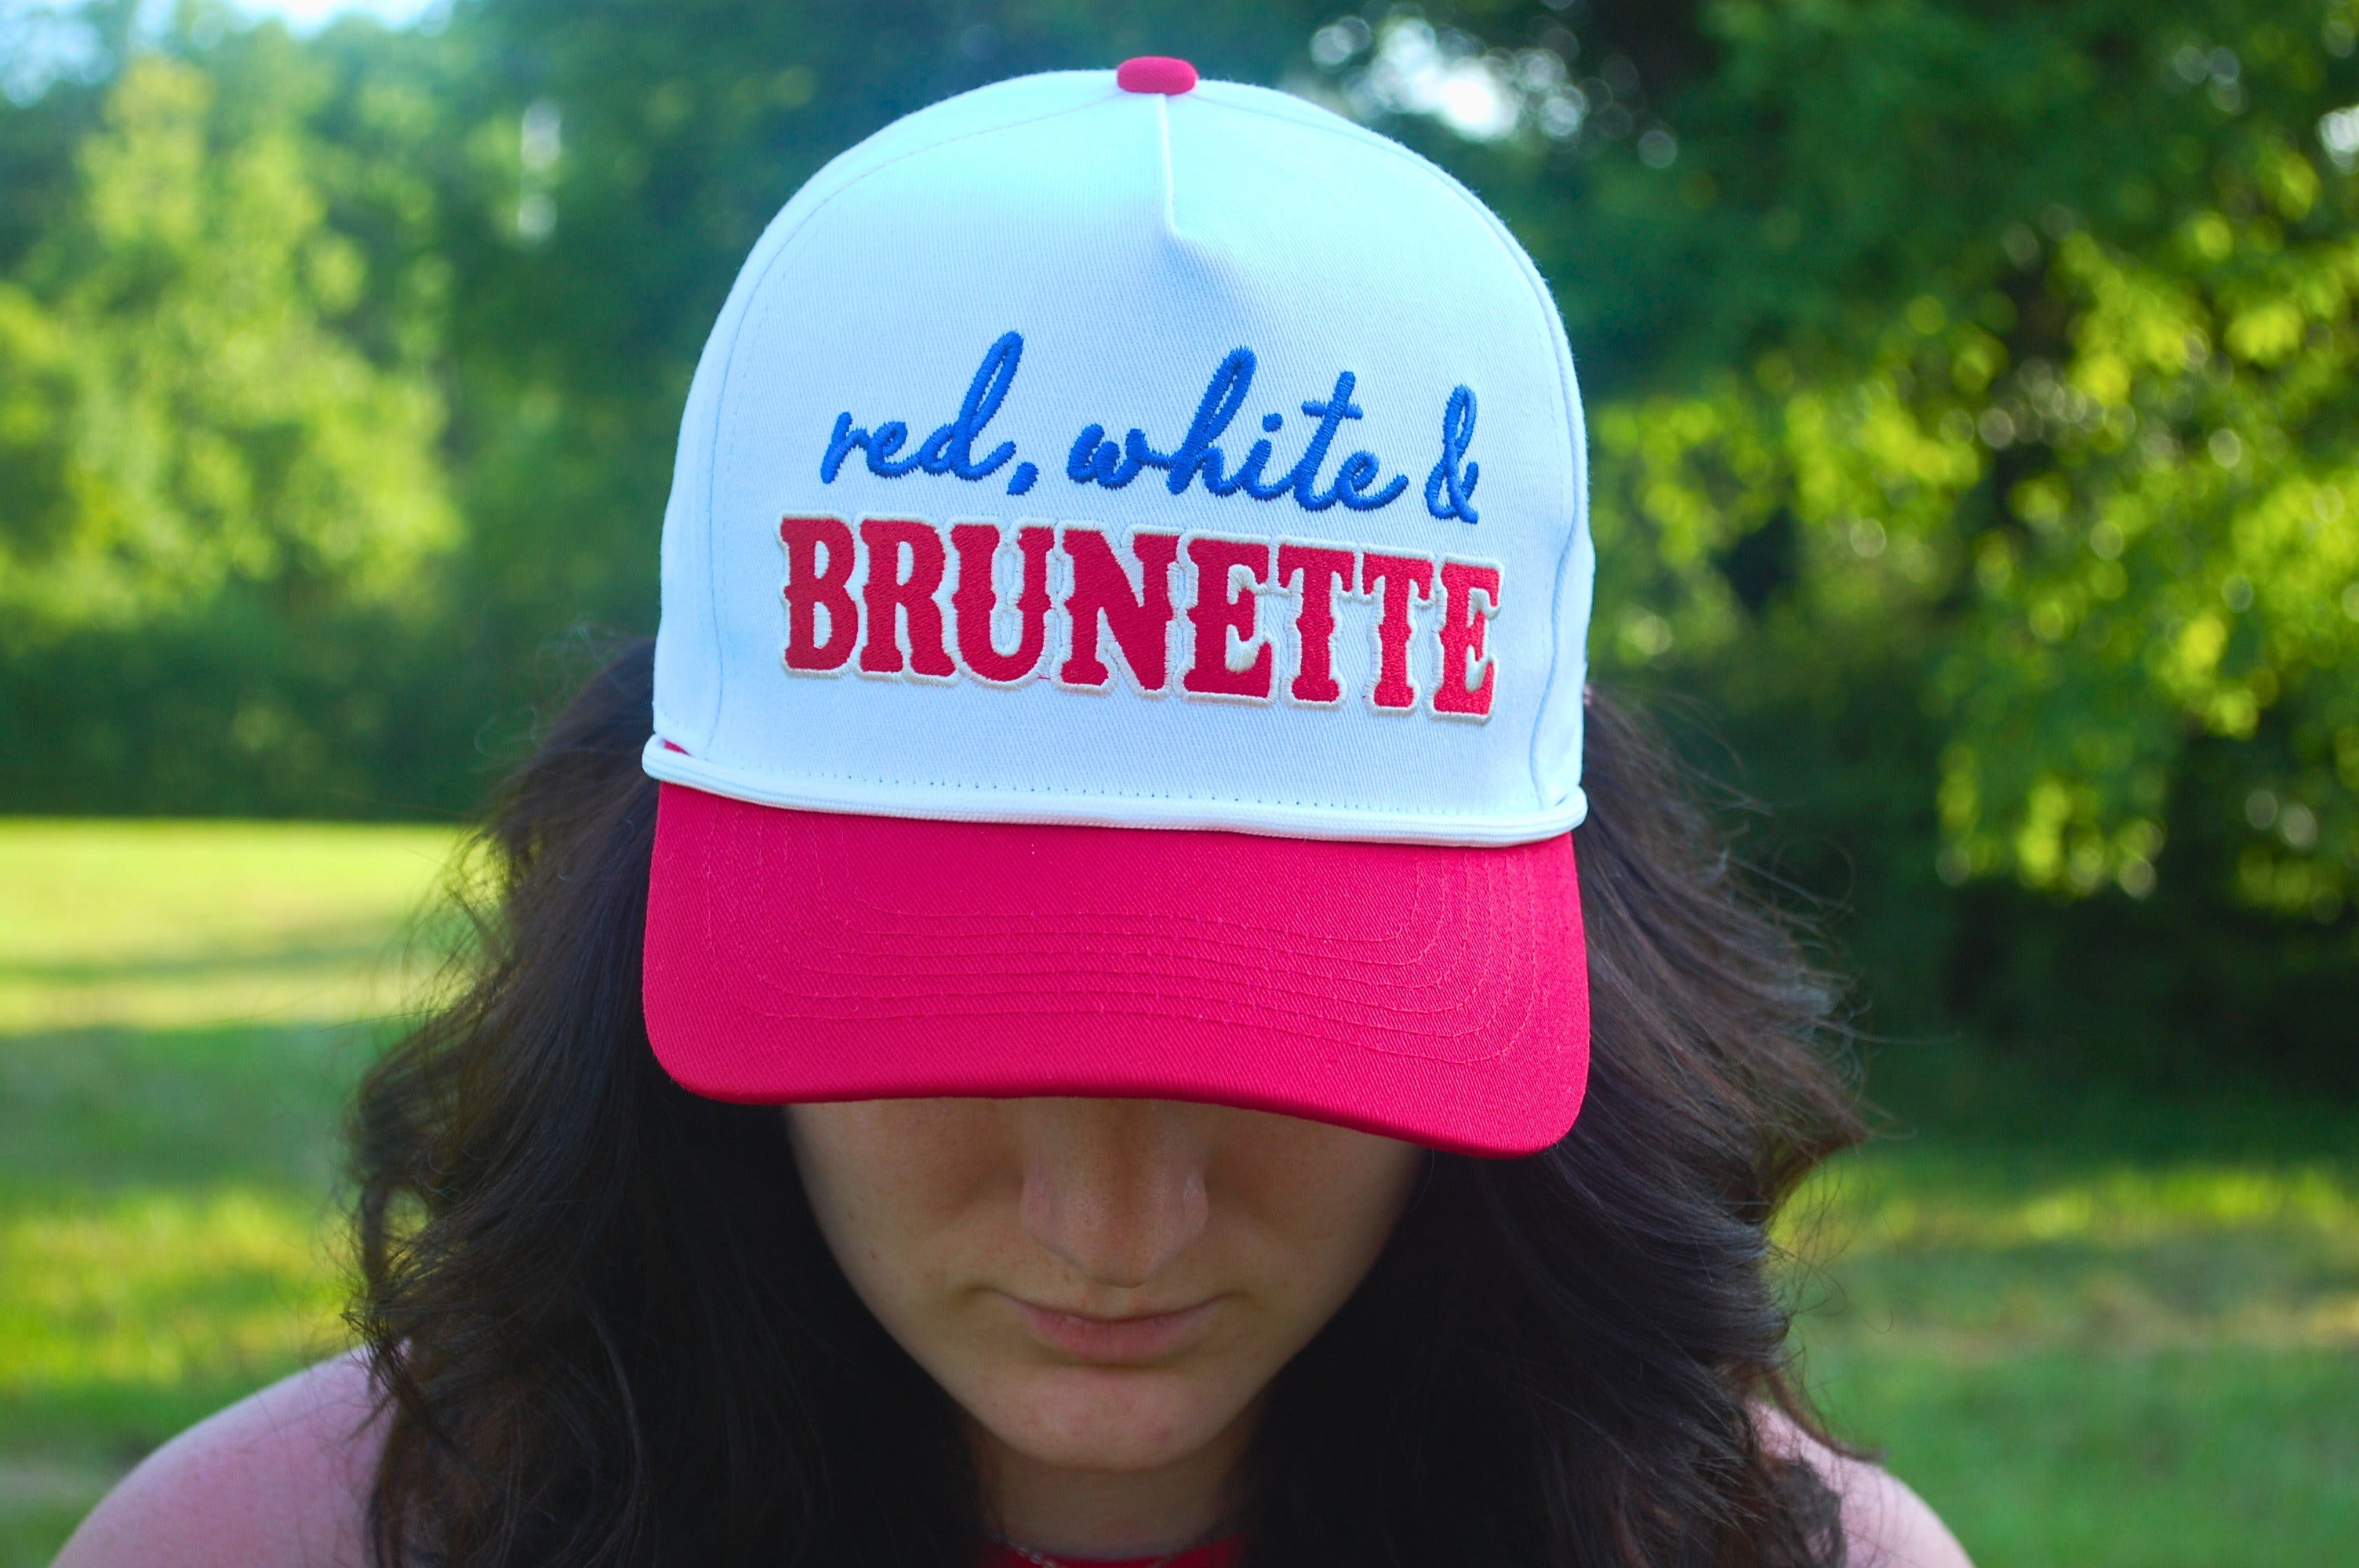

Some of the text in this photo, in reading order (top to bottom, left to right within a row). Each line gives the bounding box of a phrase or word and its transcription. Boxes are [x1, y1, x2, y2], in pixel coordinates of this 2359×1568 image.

[820, 330, 1480, 524] red, white &
[777, 514, 1503, 721] BRUNETTE
